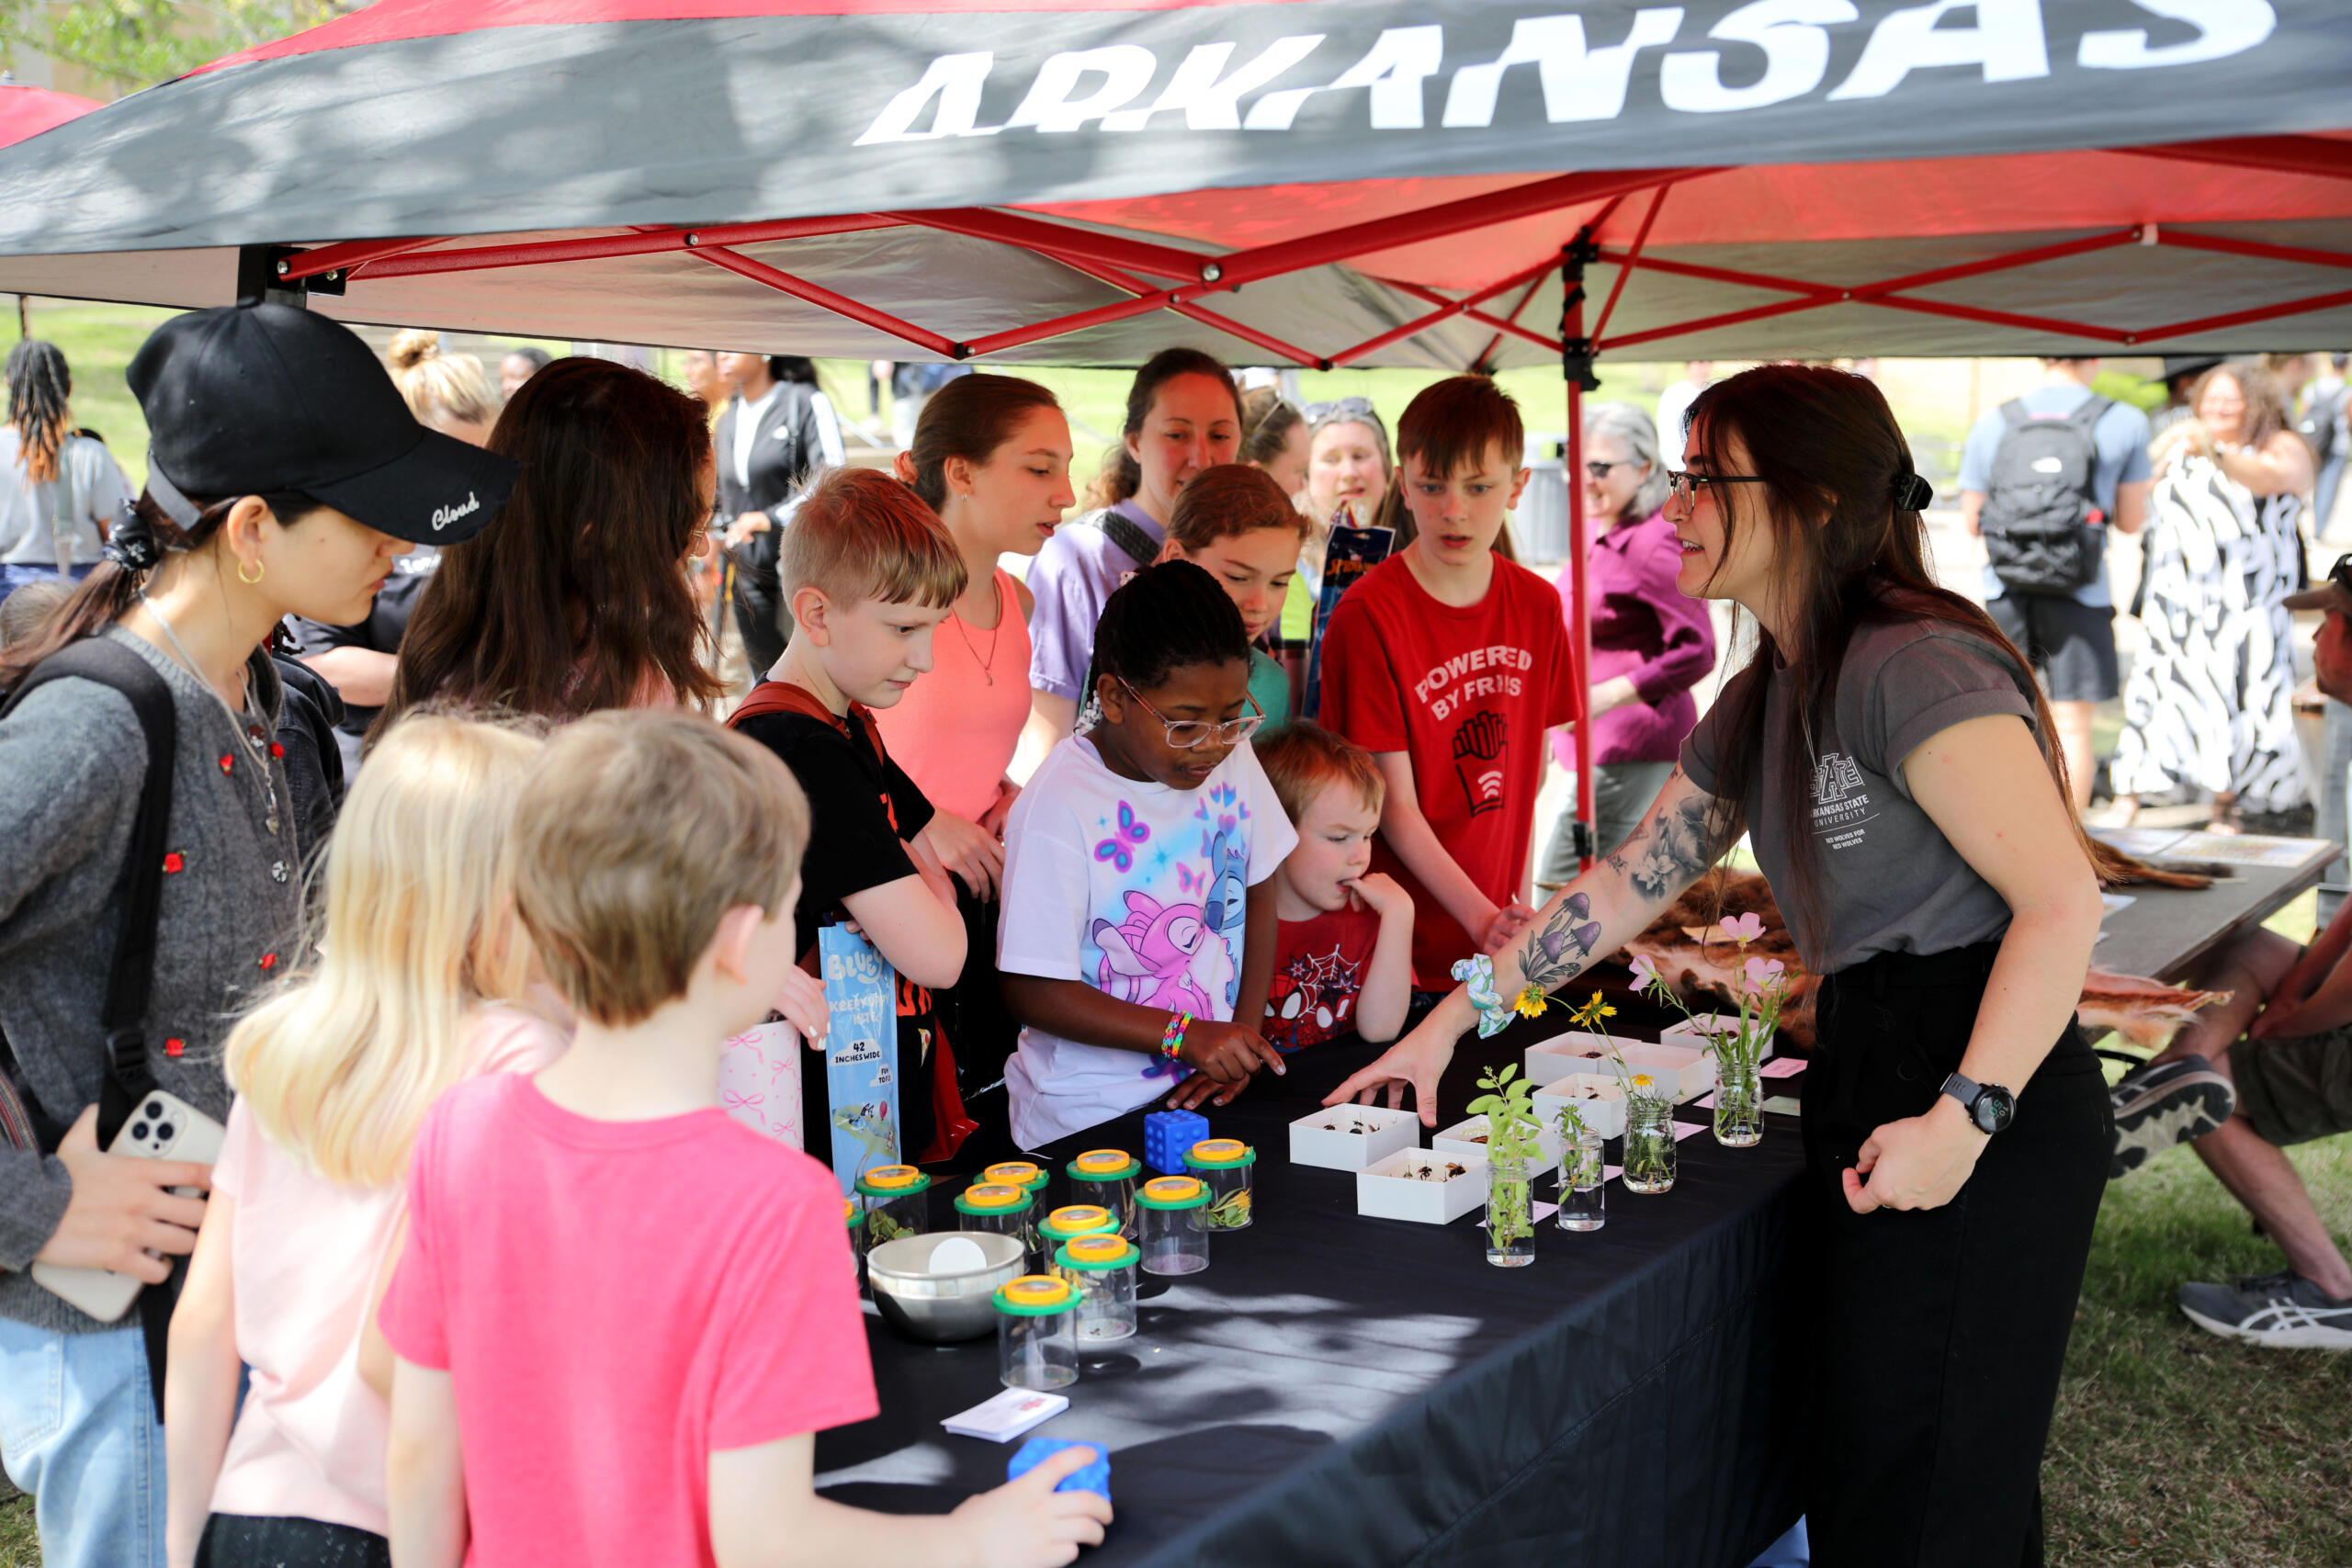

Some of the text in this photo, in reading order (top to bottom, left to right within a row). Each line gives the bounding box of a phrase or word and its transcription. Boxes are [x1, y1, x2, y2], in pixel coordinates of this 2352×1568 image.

[432, 491, 480, 531] Cloud
[1415, 645, 1532, 704] POWERED
[1430, 690, 1459, 721] BY
[1844, 795, 1869, 809] STATE
[1815, 807, 1866, 827] UNIVERSITY
[853, 1042, 865, 1052] 42
[835, 1051, 881, 1064] INCHES WIDE
